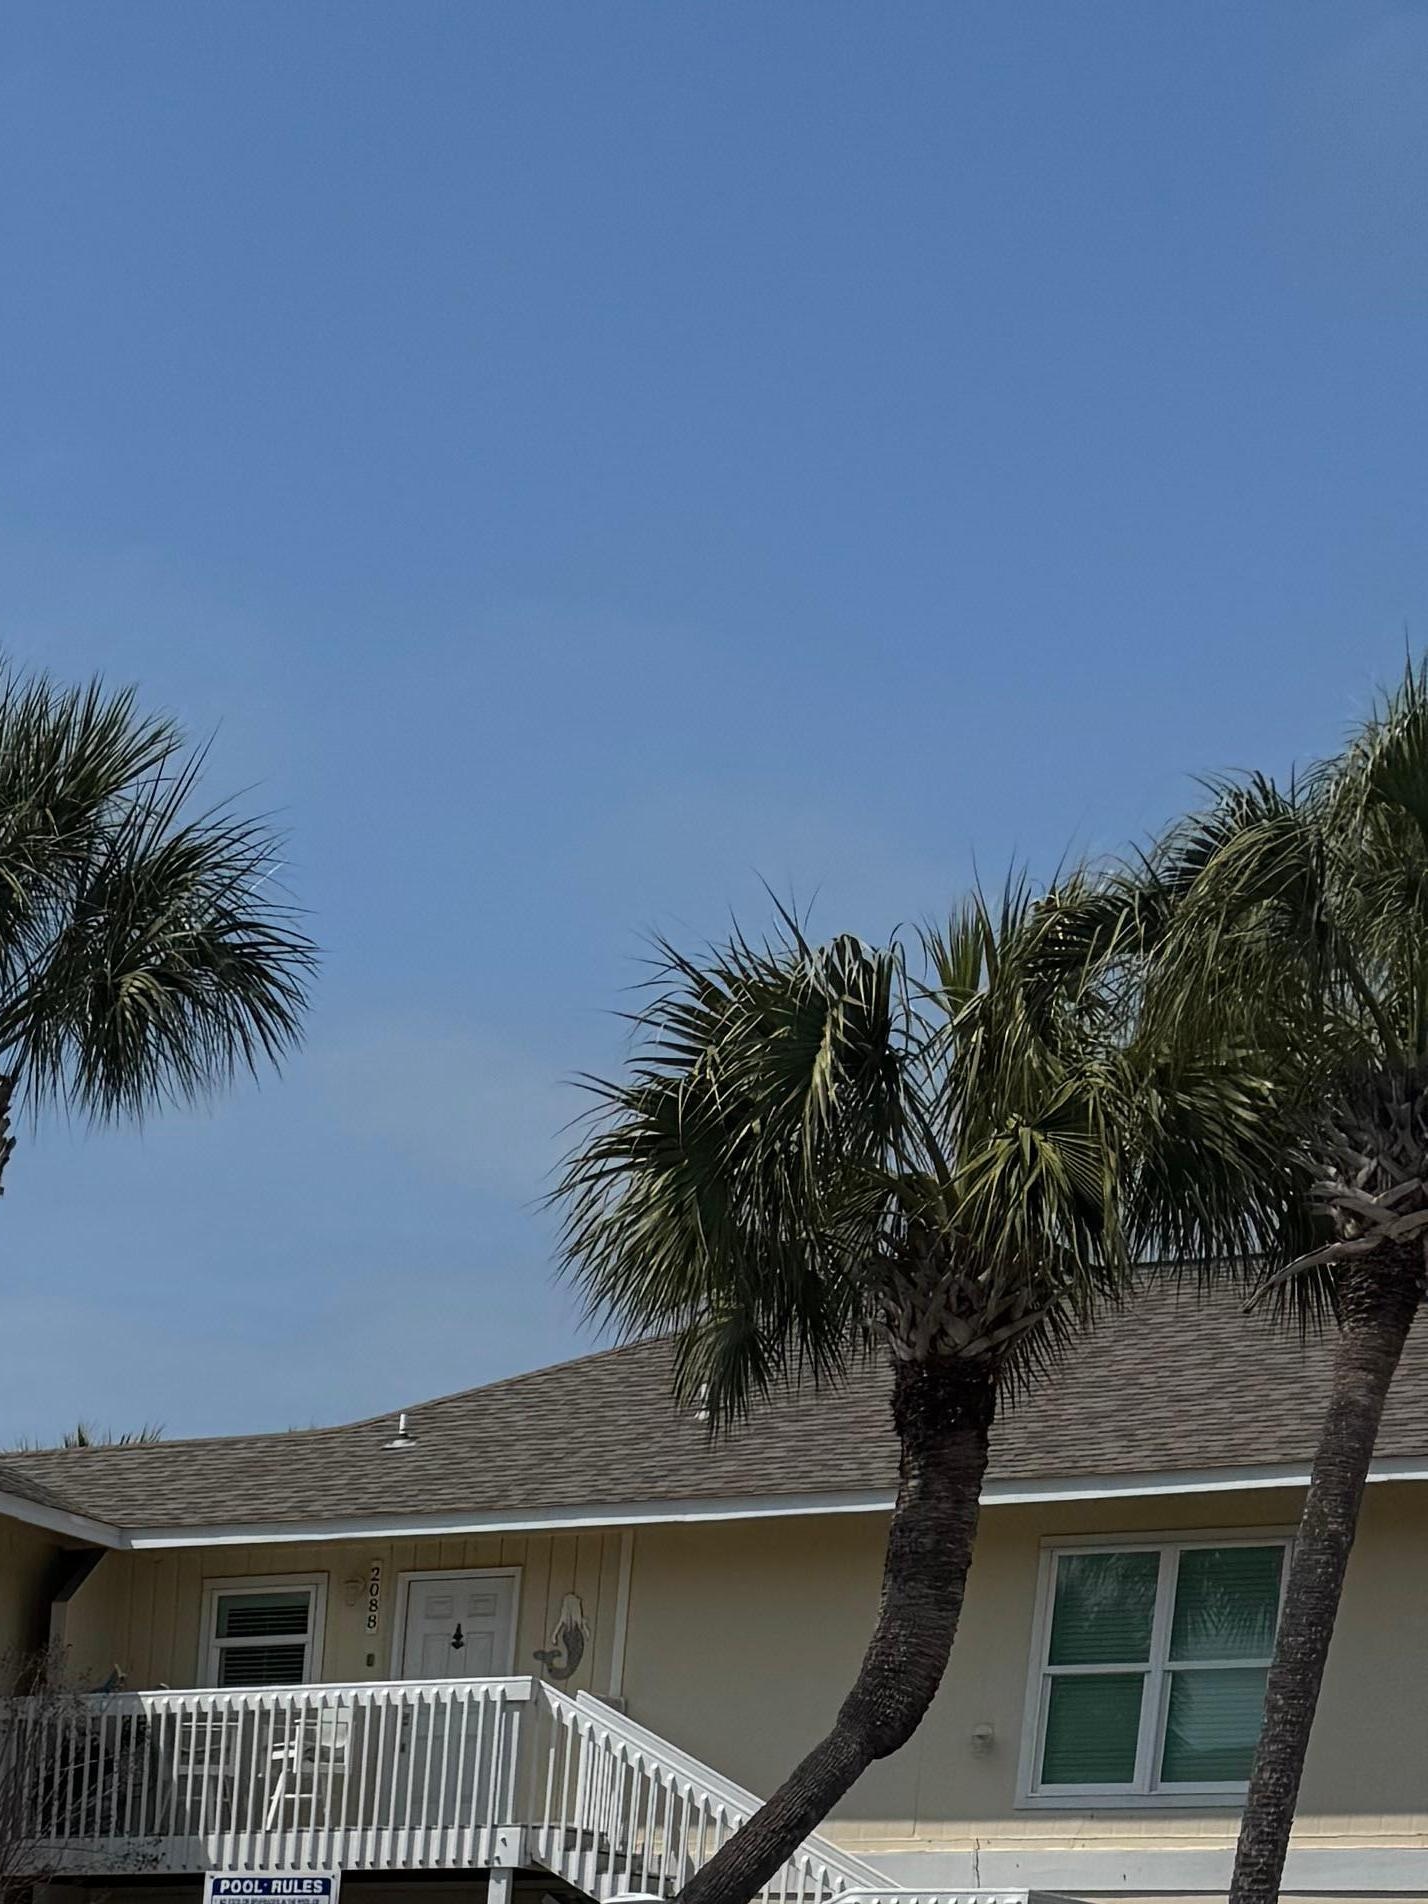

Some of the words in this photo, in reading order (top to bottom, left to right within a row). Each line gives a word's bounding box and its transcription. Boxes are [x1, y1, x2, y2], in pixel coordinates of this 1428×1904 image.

[367, 1567, 380, 1629] 2088
[219, 1879, 263, 1894] POOL
[270, 1879, 324, 1894] RULES
